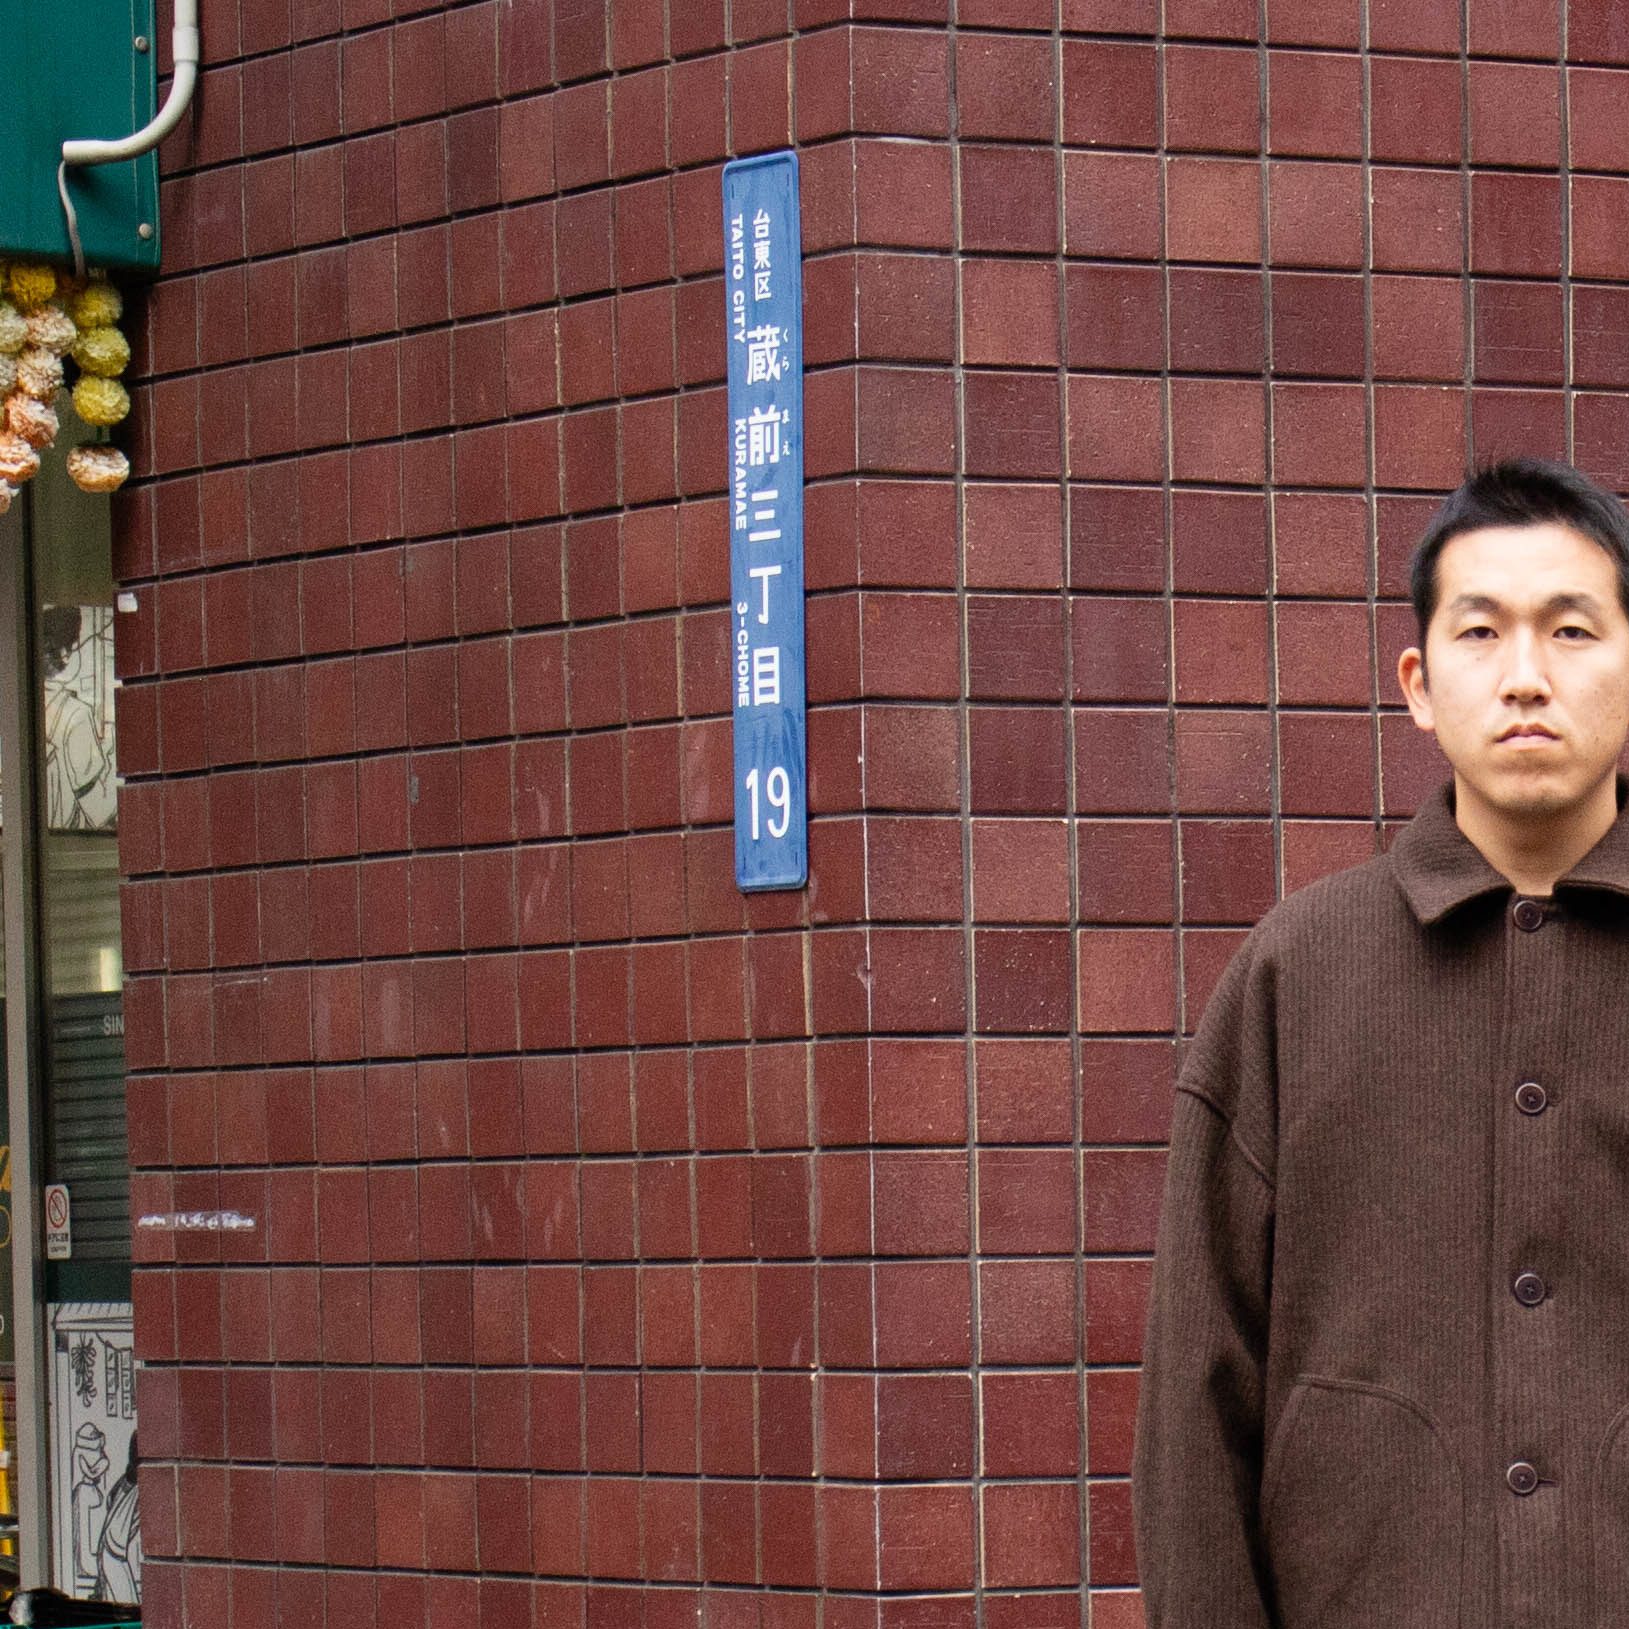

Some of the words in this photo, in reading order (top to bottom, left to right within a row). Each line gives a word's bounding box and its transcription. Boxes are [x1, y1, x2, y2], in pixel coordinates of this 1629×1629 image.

[731, 213, 744, 280] TAITO
[752, 208, 772, 302] 台東区
[732, 289, 746, 344] CITY
[734, 417, 748, 531] KURAMAE
[746, 323, 782, 707] 蔵前三丁目
[736, 601, 750, 708] 3-CHOME
[745, 766, 791, 840] 19
